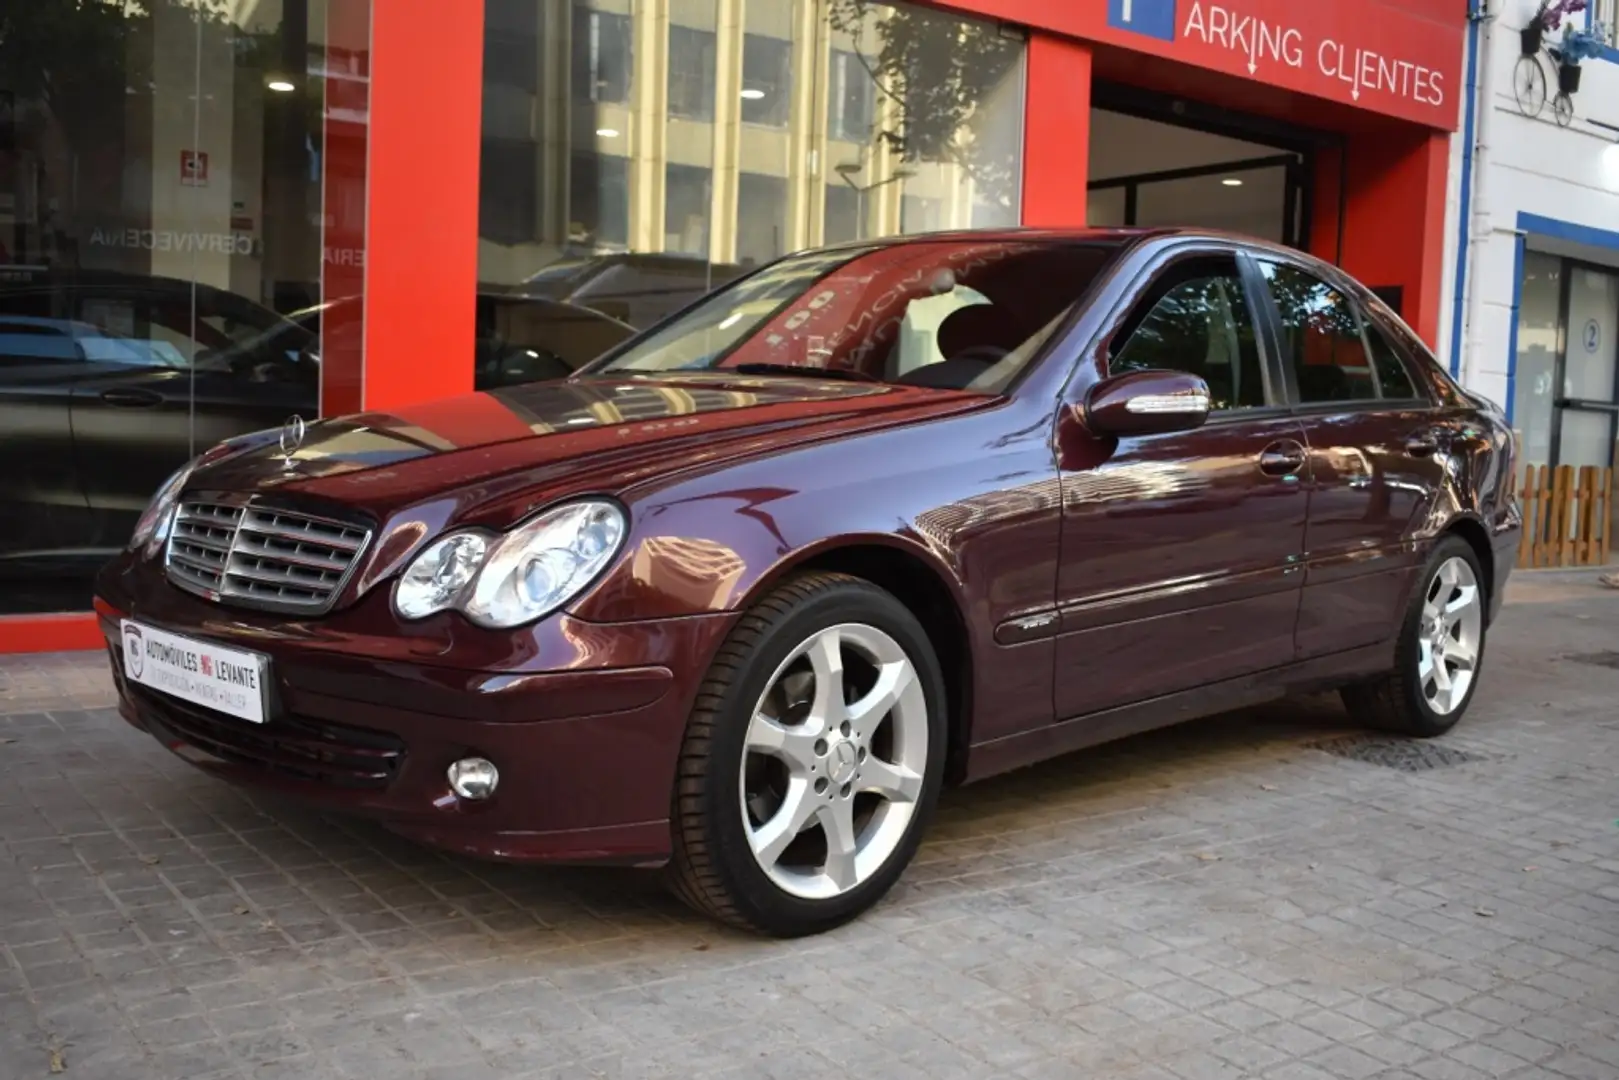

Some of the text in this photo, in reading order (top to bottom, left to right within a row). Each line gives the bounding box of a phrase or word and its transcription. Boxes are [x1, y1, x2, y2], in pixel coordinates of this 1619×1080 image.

[1184, 1, 1444, 106] ARKING CLIENTES
[146, 639, 198, 673] AUTOMÓVILES
[215, 659, 257, 689] LEVANTE
